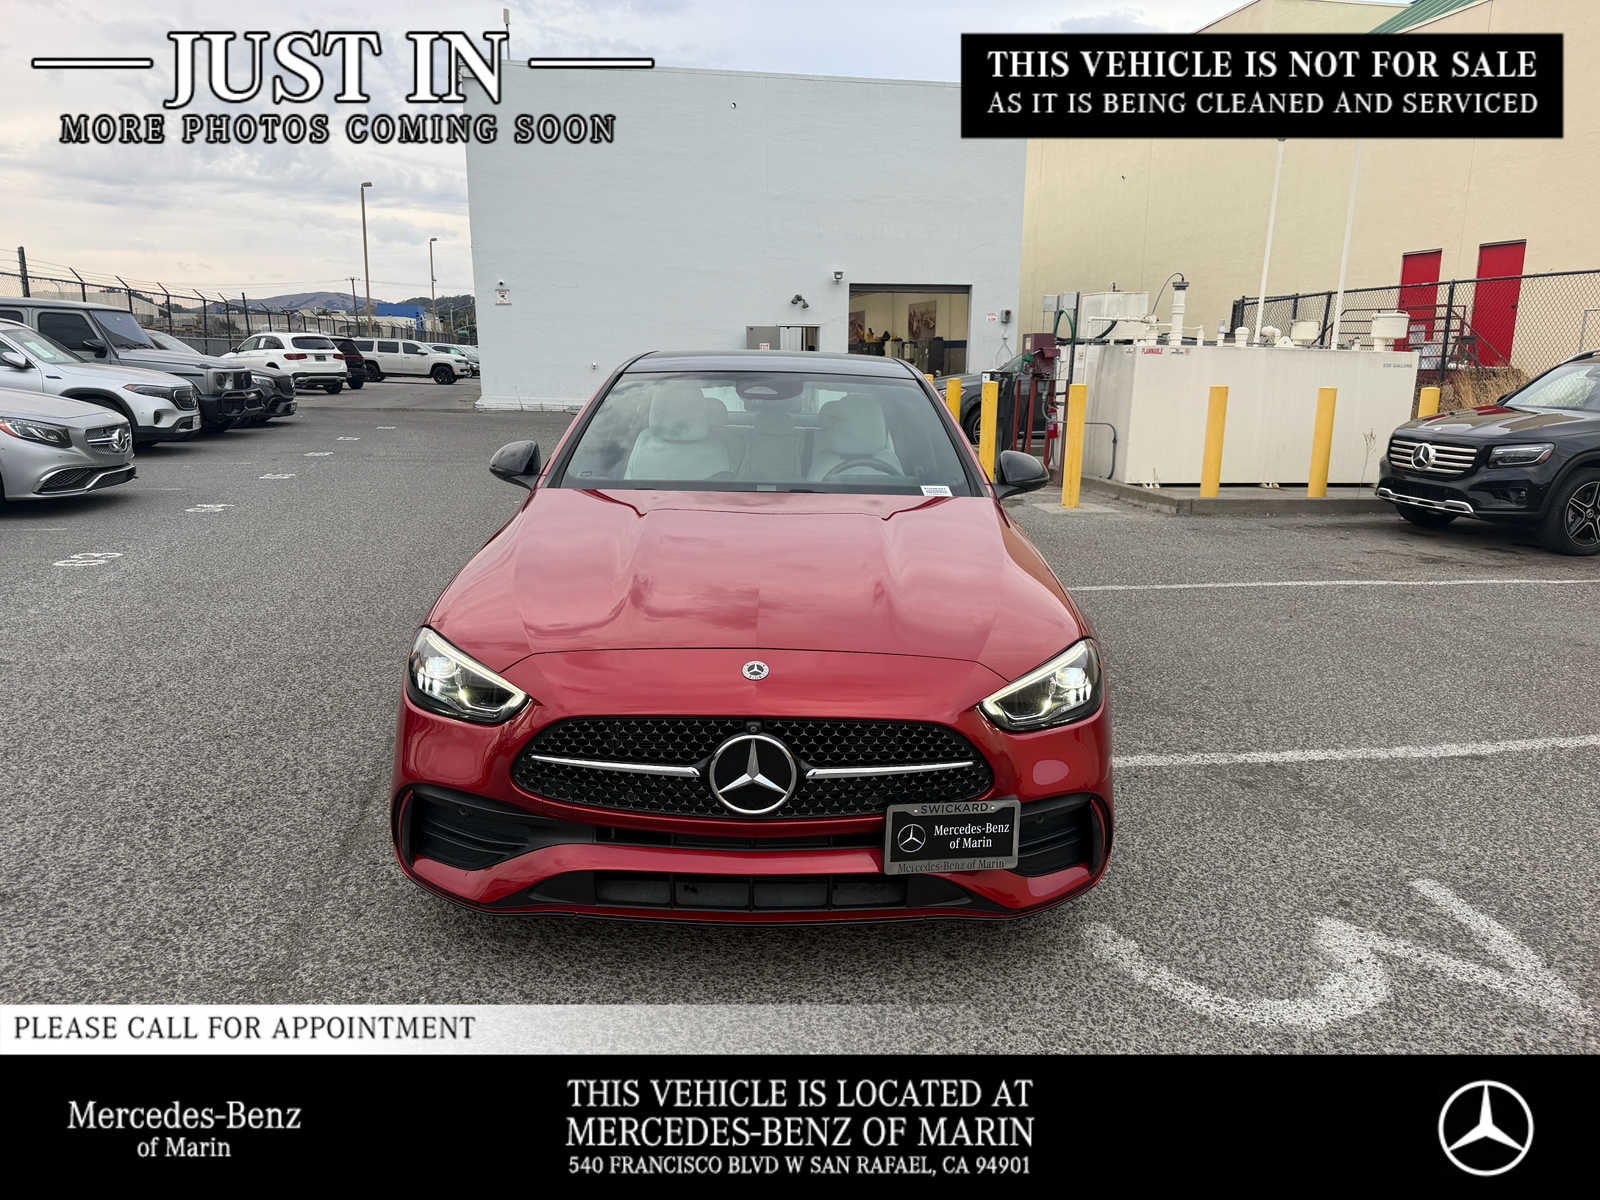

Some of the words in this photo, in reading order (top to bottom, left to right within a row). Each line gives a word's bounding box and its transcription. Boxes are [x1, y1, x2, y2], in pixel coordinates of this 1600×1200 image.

[921, 803, 988, 814] SWICKARD
[934, 823, 1010, 836] Mercedes-Benz
[950, 838, 961, 849] of
[963, 838, 992, 849] Marin
[898, 862, 964, 873] Mercedes-Benz
[967, 860, 976, 869] of
[979, 859, 1004, 868] Marin
